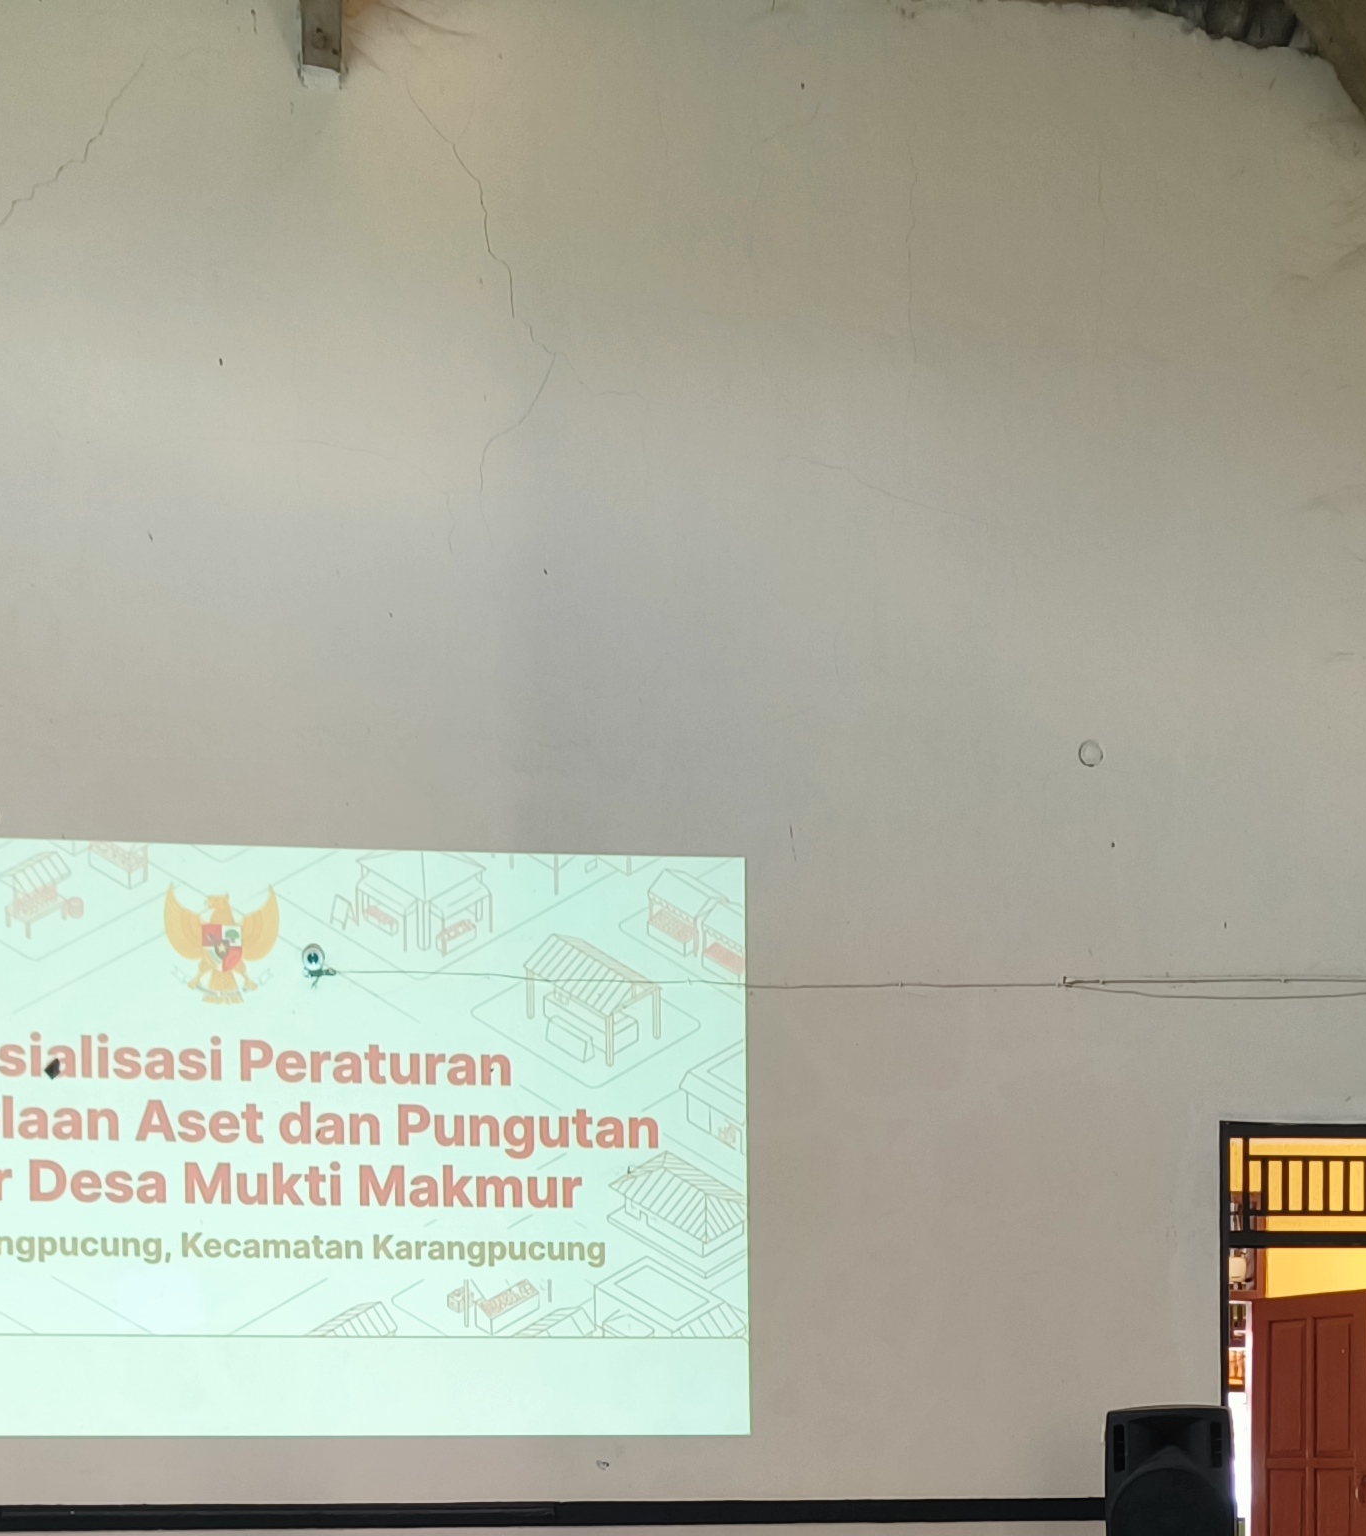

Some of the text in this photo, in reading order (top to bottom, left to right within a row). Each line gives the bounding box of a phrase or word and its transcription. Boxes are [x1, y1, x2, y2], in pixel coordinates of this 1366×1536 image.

[238, 1039, 514, 1087] Peraturan
[135, 1099, 265, 1146] Aset
[278, 1101, 383, 1147] dan
[396, 1103, 661, 1161] Pungutan
[28, 1159, 169, 1206] Desa
[183, 1161, 344, 1208] Mukti
[358, 1164, 585, 1211] Makmur
[181, 1233, 365, 1261] Kecamatan
[372, 1236, 608, 1269] Karangpucung
